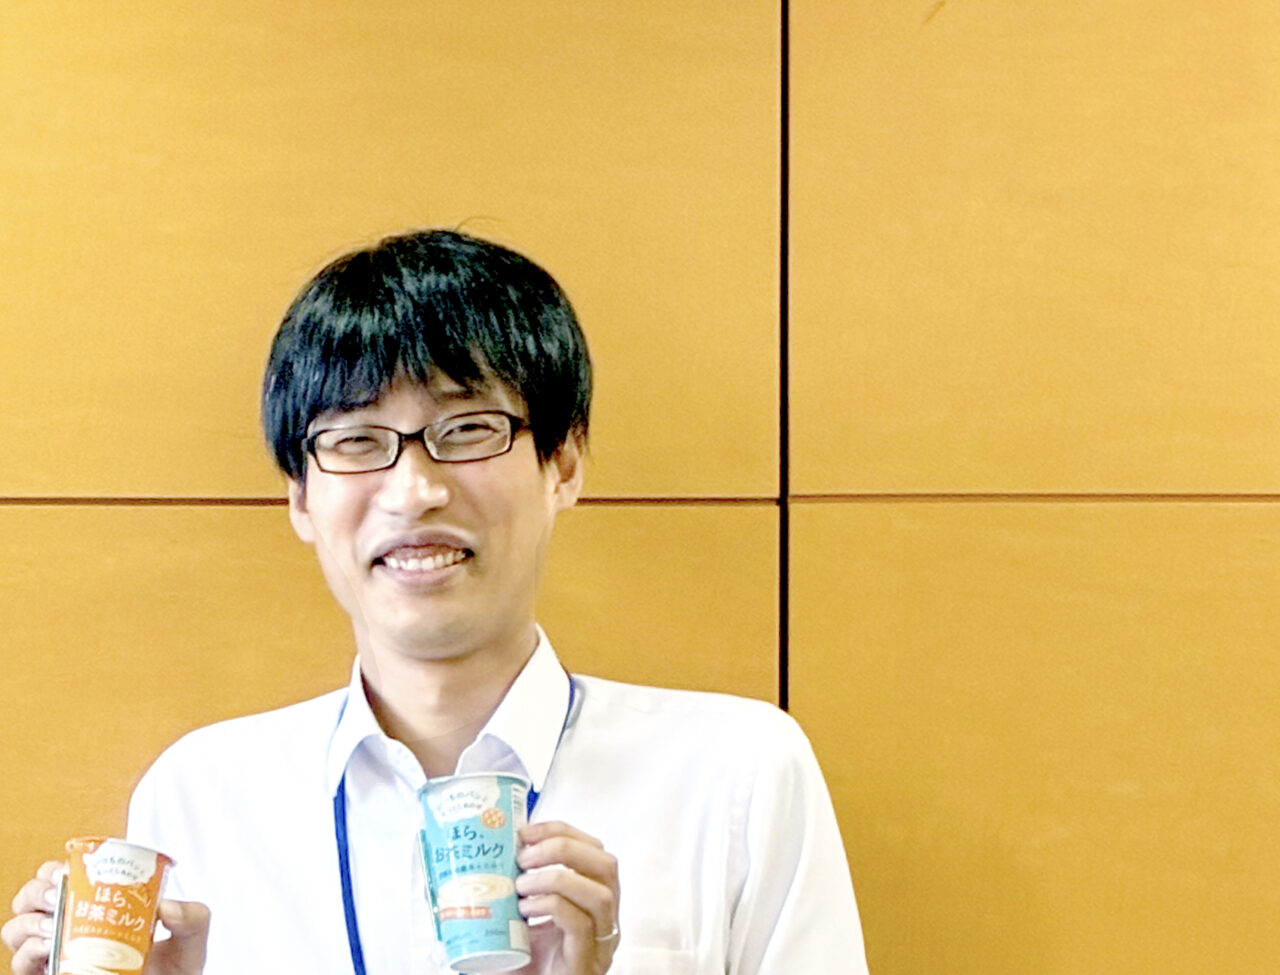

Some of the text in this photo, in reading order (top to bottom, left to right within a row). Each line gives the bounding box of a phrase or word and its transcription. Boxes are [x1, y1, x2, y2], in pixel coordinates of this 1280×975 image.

[435, 842, 505, 865] お茶ミルク
[95, 886, 132, 909] ほら、
[75, 900, 145, 932] お茶ミルク
